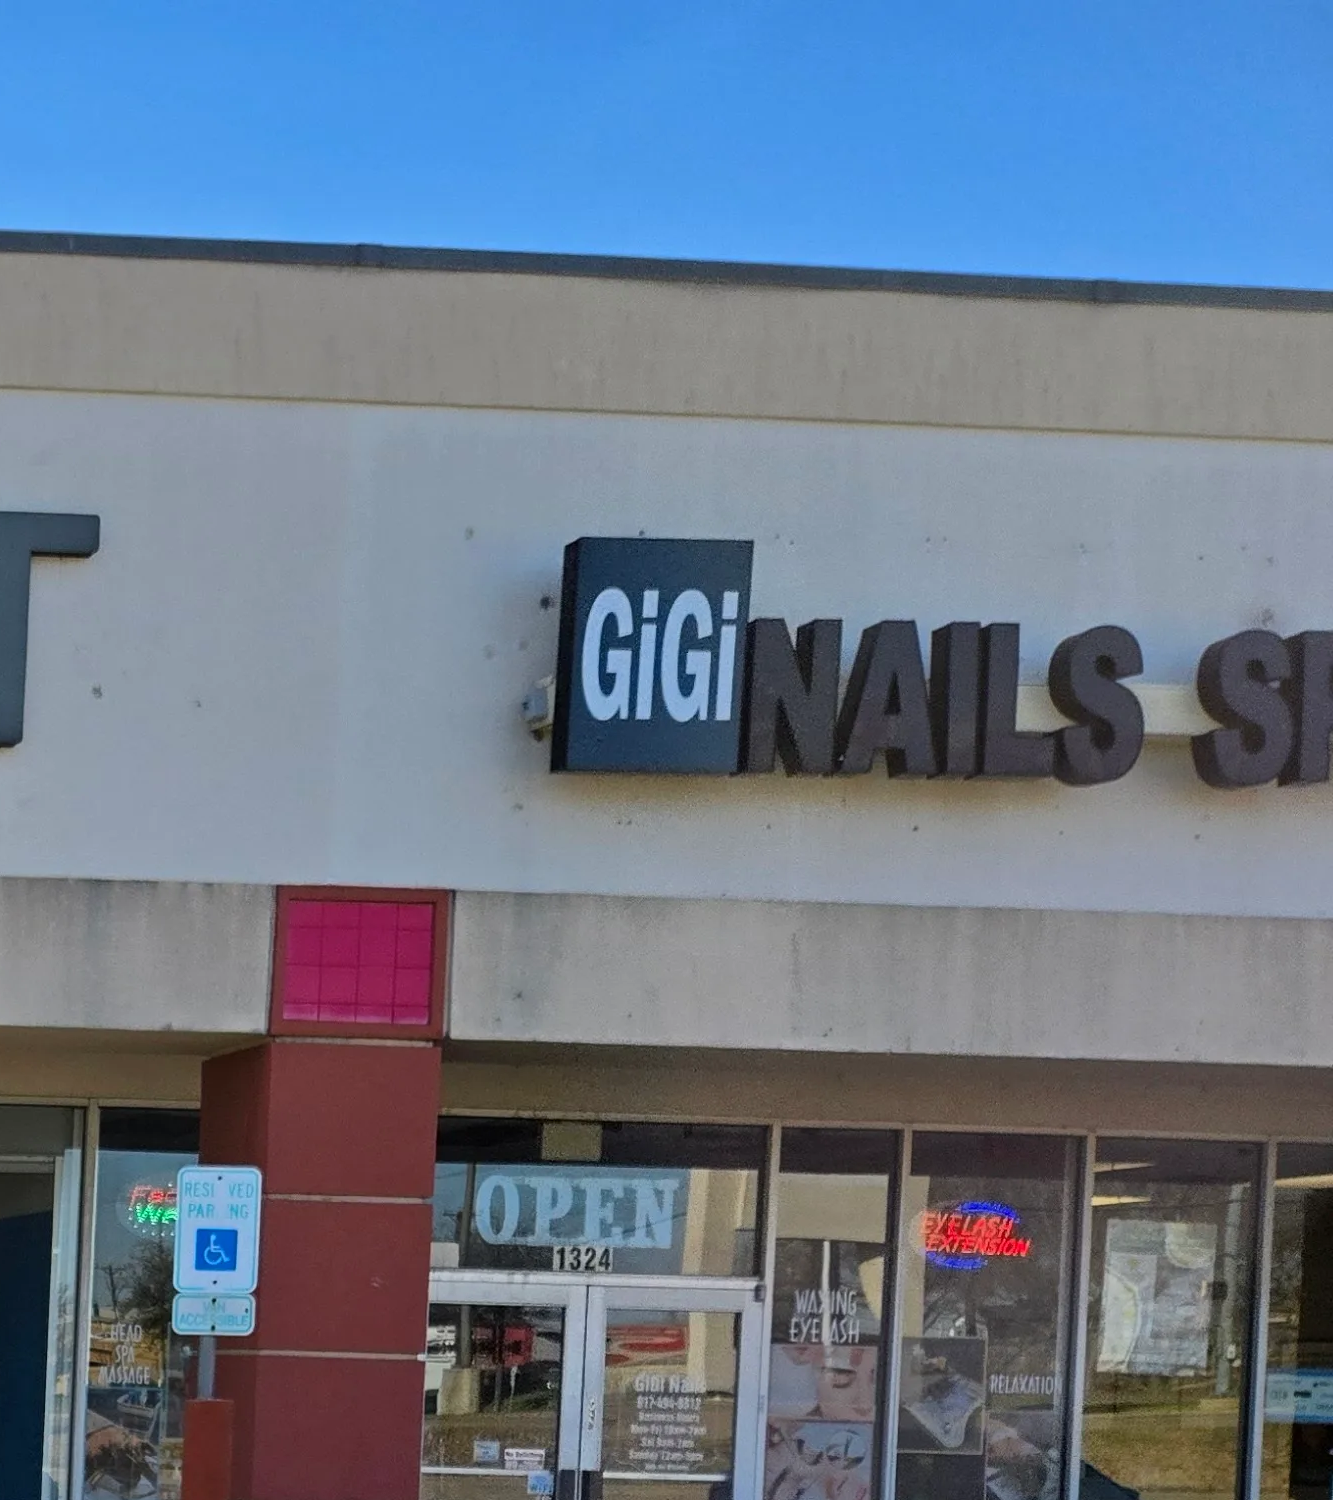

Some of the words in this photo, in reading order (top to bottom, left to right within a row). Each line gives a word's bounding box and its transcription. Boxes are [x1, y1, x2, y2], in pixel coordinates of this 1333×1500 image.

[581, 588, 739, 722] GiGi
[741, 617, 1144, 787] NAILS
[185, 1182, 254, 1199] RESVED
[188, 1203, 250, 1219] PARNG
[476, 1175, 679, 1249] OPEN
[920, 1210, 1014, 1237] EYELASH
[925, 1233, 1031, 1257] EXTENSION
[556, 1247, 611, 1271] 1324
[794, 1288, 857, 1315] WAXING
[110, 1324, 143, 1343] HEAD
[789, 1317, 860, 1344] EYEASH
[115, 1344, 135, 1364] SPA
[98, 1366, 151, 1385] MASSAGE
